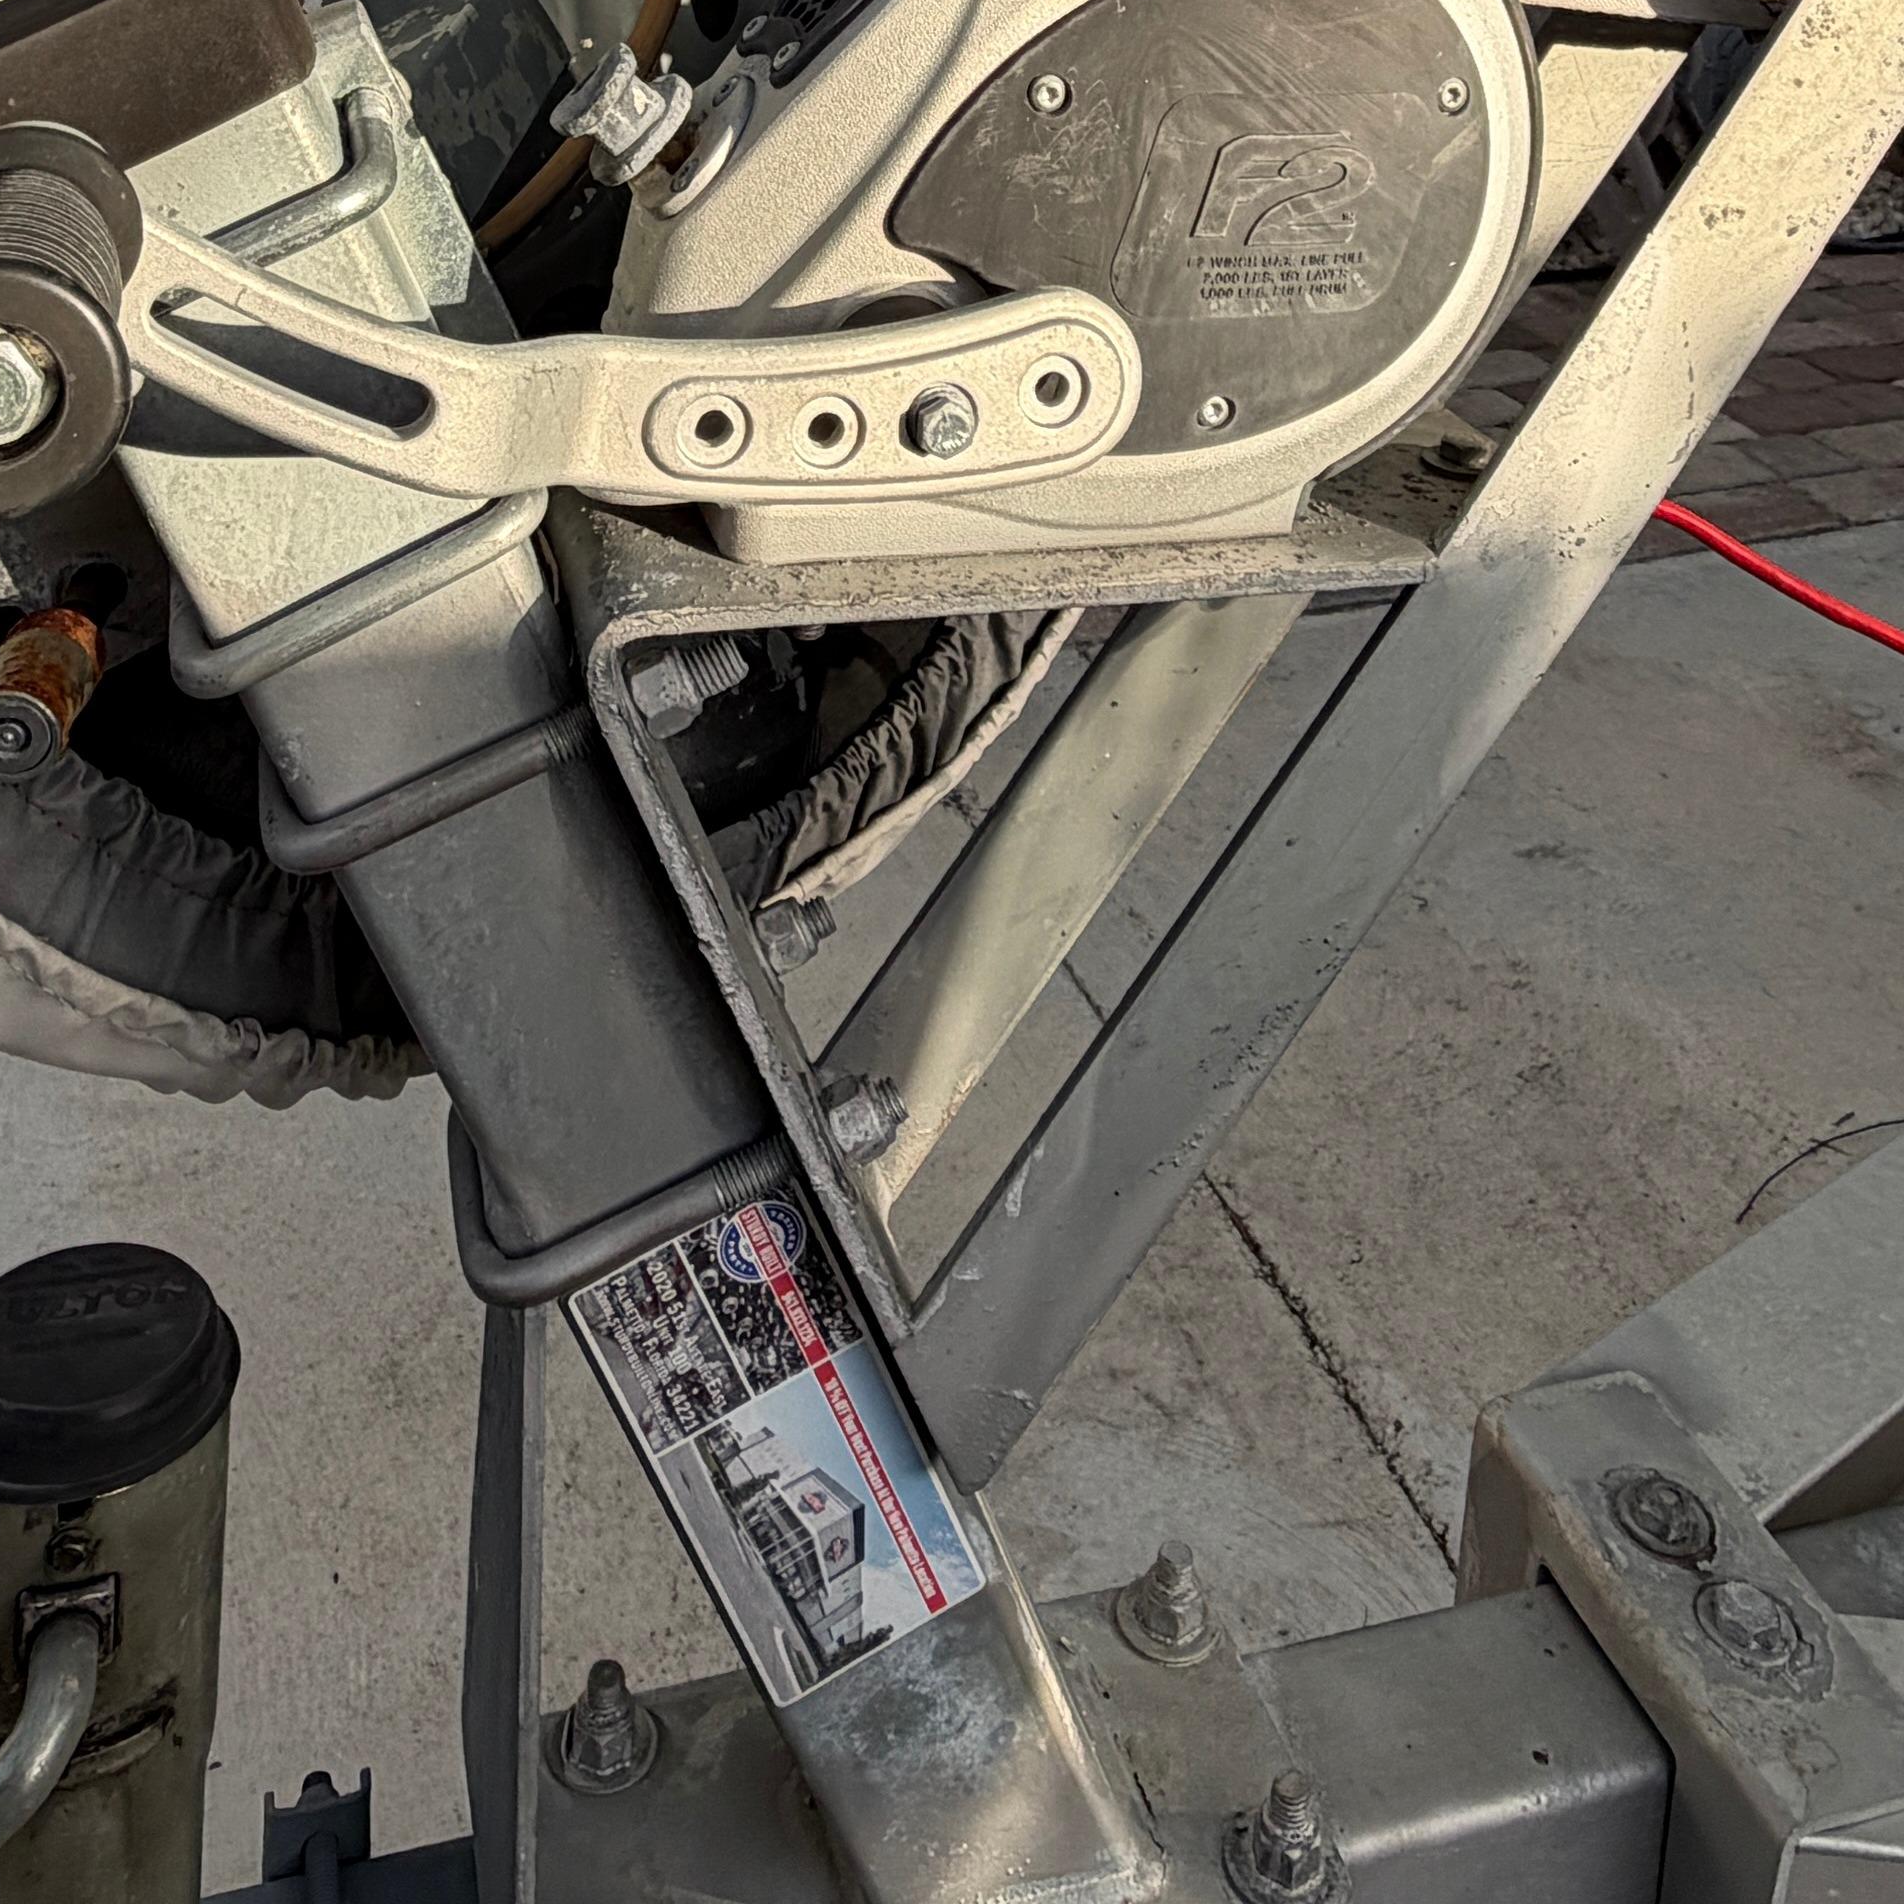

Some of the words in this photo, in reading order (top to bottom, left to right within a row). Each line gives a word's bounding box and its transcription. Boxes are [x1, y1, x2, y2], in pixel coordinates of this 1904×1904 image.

[1210, 255, 1257, 268] WINCH
[1301, 253, 1329, 266] LINE
[1334, 251, 1363, 264] PULL
[740, 1208, 770, 1248] STURDY
[645, 1260, 678, 1303] 2020
[666, 1343, 693, 1376] 100
[664, 1381, 700, 1433] 34221
